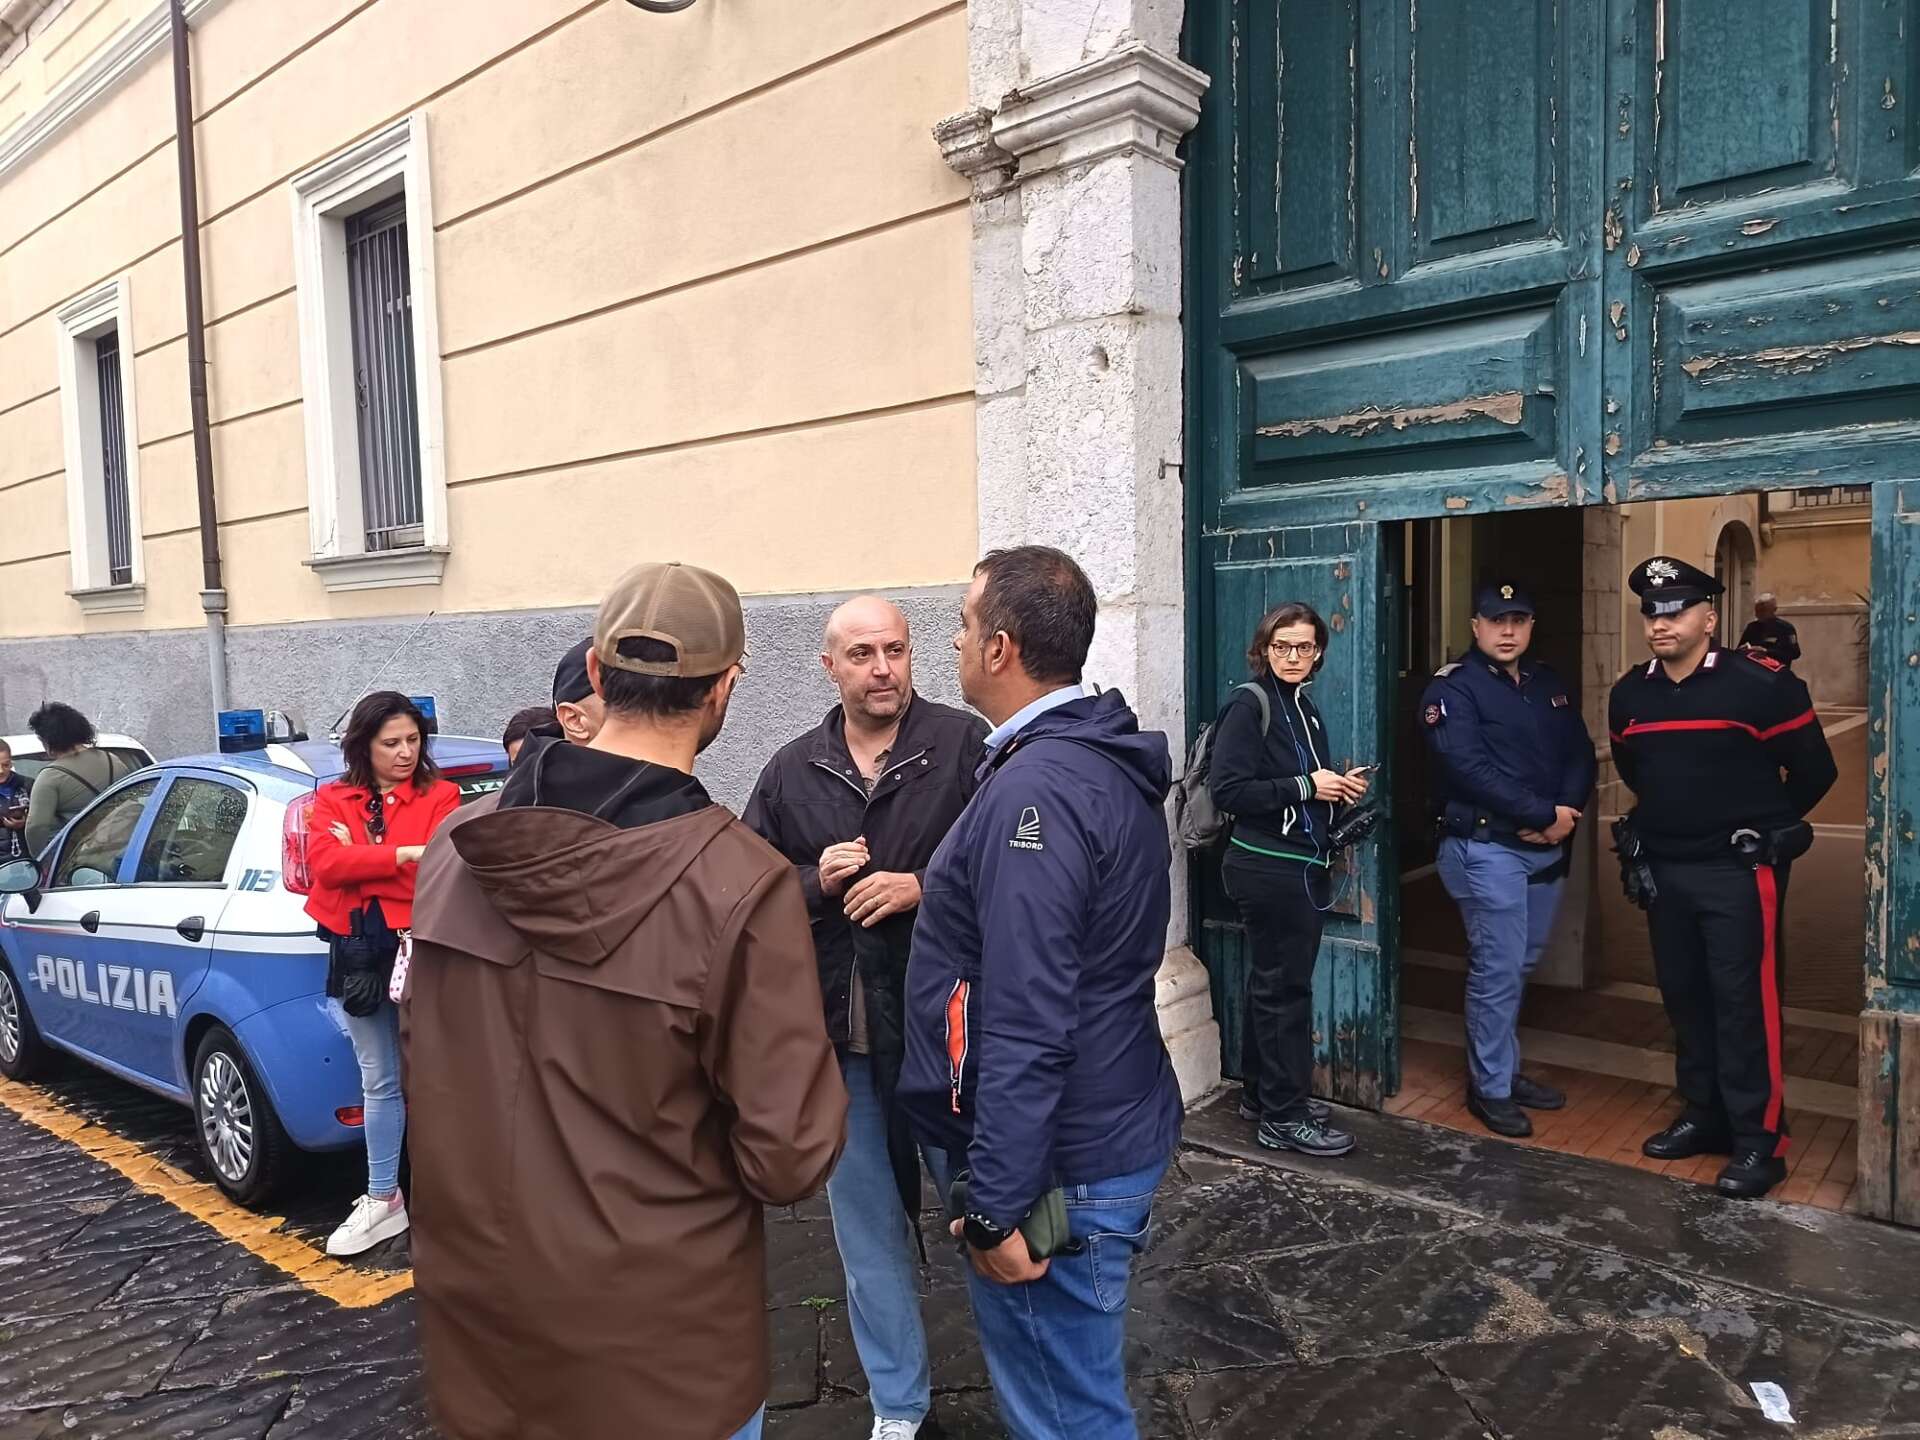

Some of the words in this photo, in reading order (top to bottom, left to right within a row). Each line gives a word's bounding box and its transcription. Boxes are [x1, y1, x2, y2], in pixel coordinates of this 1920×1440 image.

[1008, 839, 1044, 851] TRIBORD
[237, 868, 281, 892] 113
[36, 954, 177, 1019] POLIZIA
